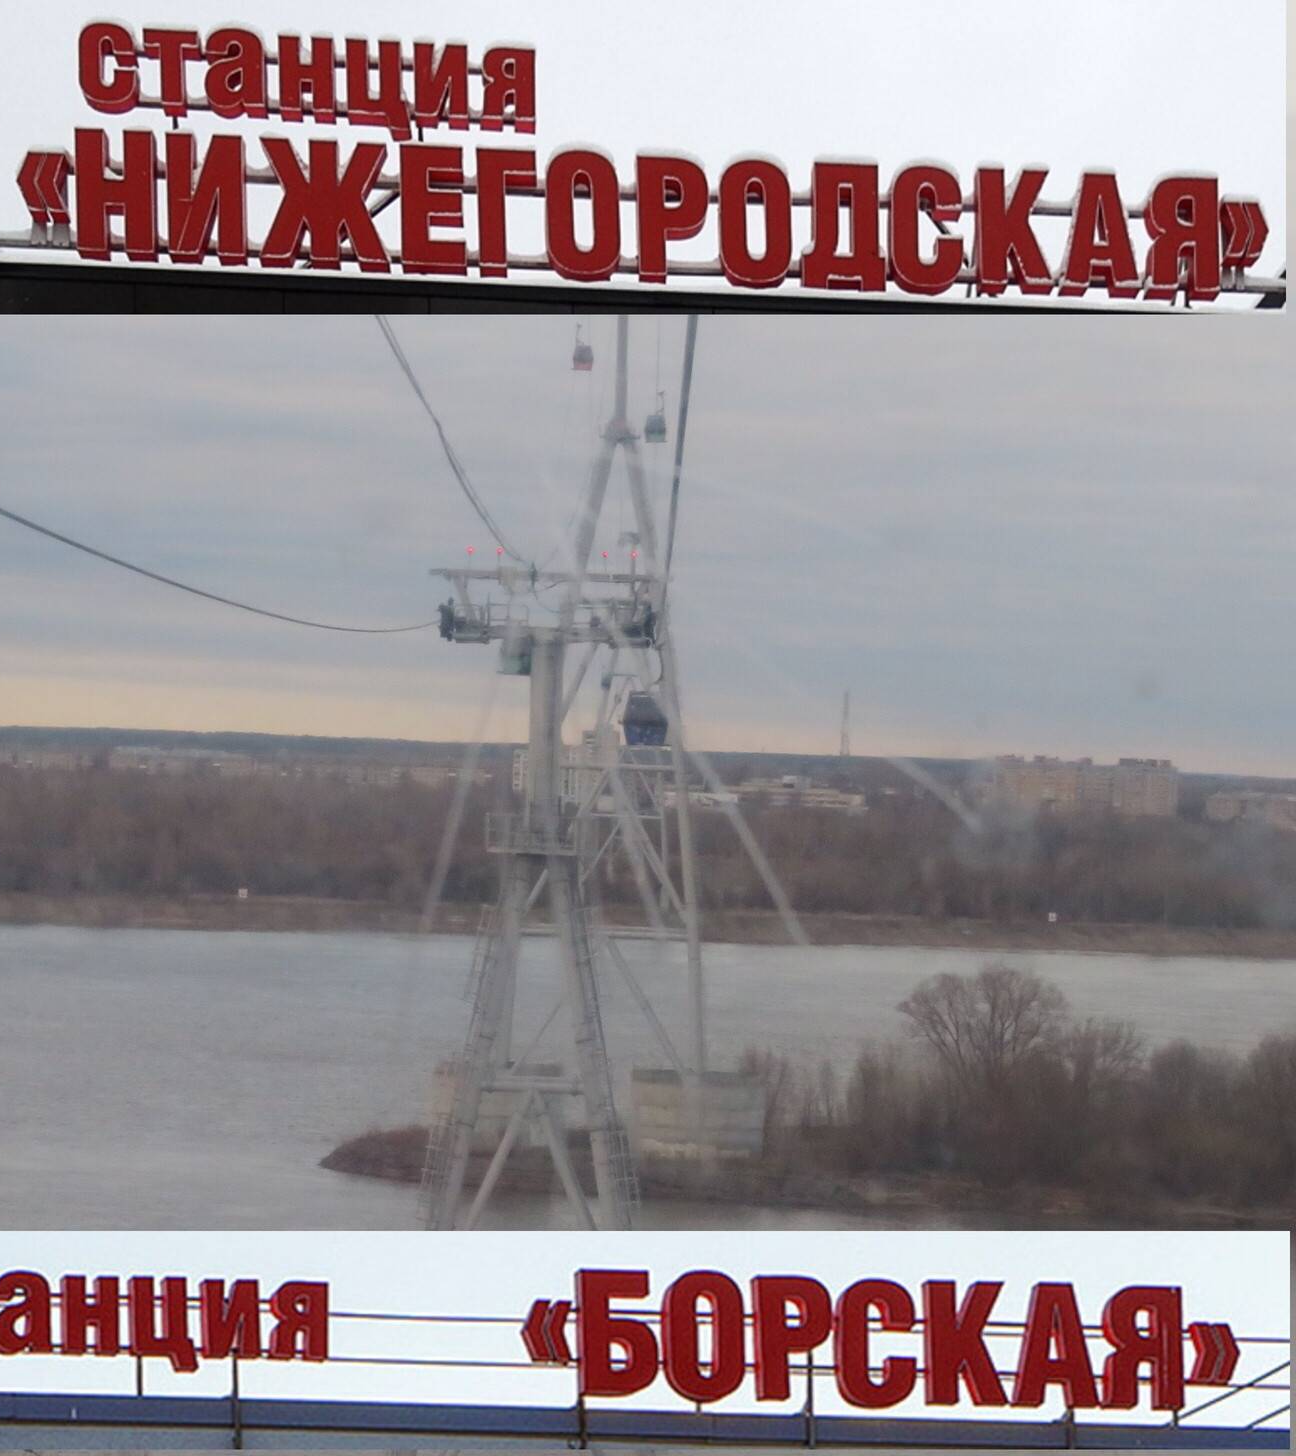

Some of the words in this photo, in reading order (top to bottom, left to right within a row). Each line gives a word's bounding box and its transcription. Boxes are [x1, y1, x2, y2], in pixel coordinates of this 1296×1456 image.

[78, 22, 536, 142] станция
[17, 127, 1270, 300] «НИЖЕГОРОДСКАЯ»
[521, 1269, 1241, 1413] «БОРСКАЯ»
